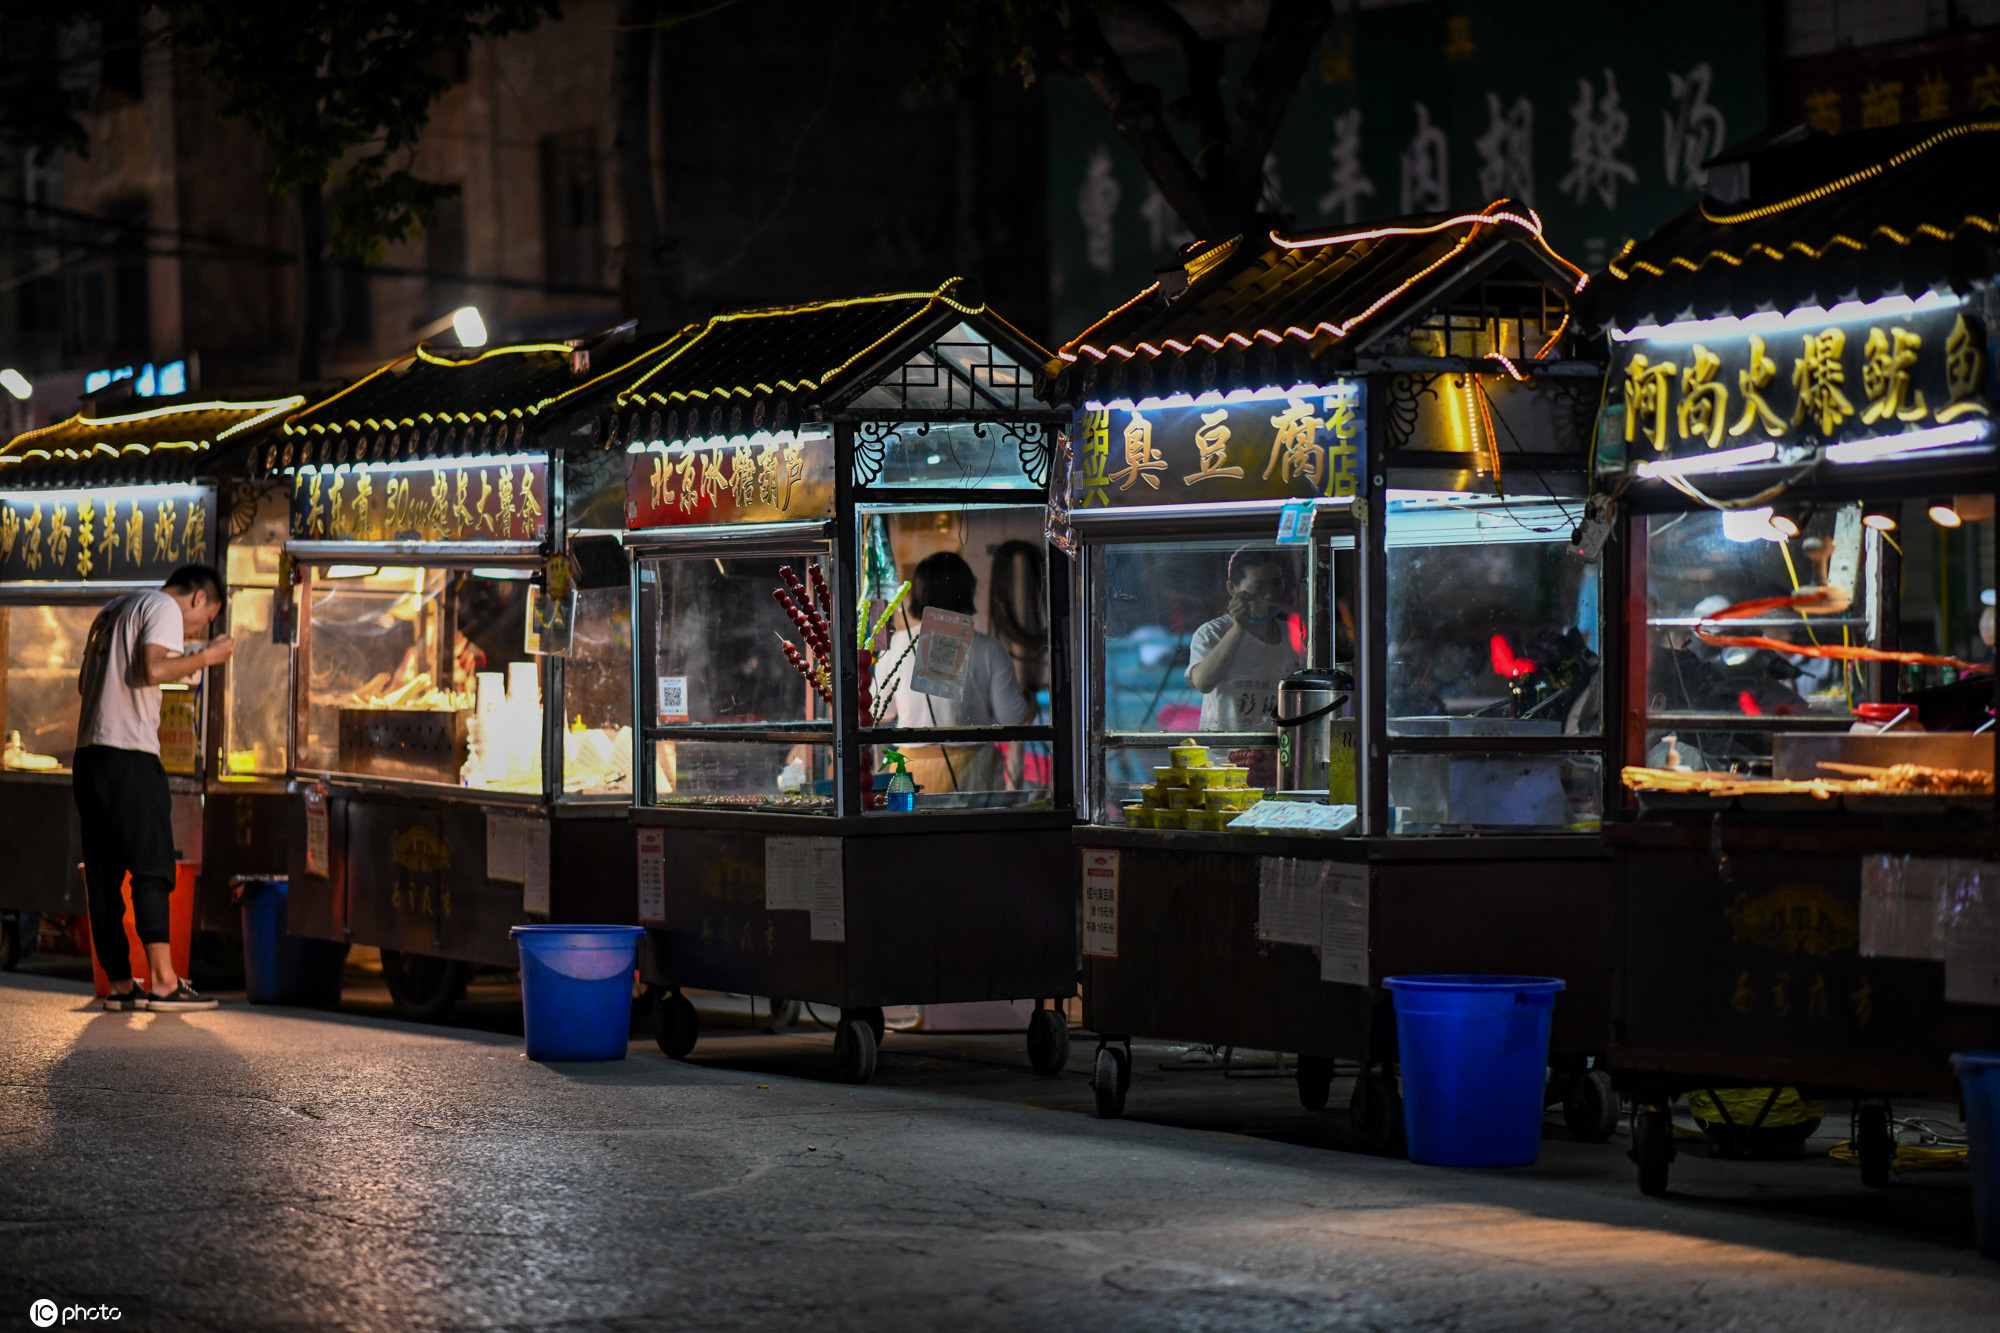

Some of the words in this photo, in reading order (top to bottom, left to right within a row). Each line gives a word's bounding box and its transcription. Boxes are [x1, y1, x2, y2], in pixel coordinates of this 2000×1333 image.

[1624, 314, 1989, 452] 阿尚火爆鱿鱼
[651, 442, 805, 516] 北京冰糖葫芦
[1082, 408, 1110, 508] 绍兴
[1108, 397, 1325, 492] 臭豆腐
[1324, 378, 1357, 498] 老店
[1086, 887, 1115, 901] 绍兴臭豆腐
